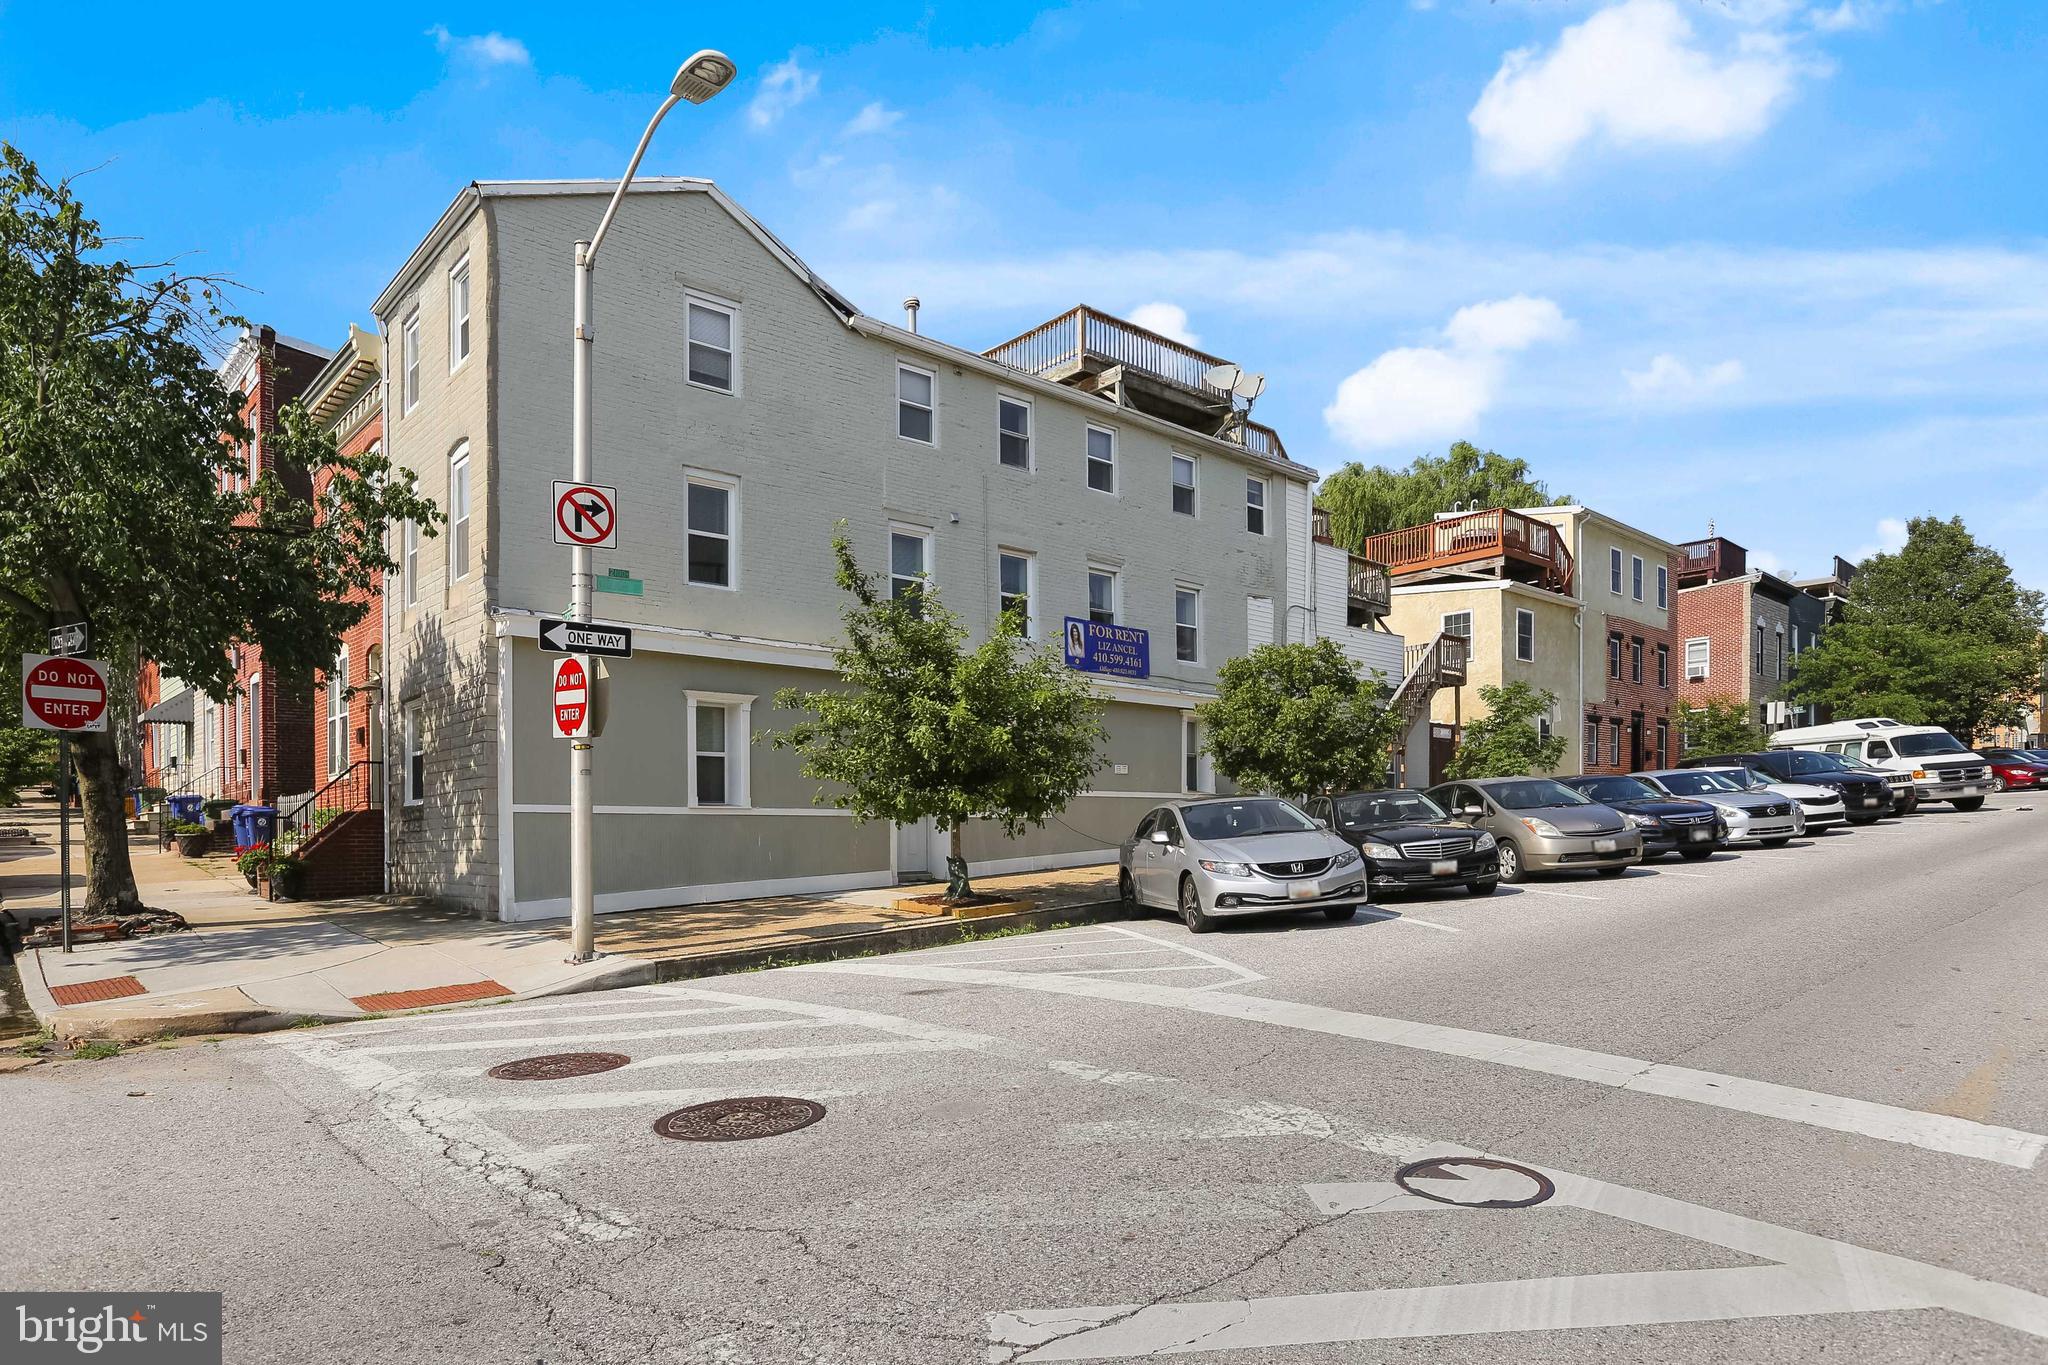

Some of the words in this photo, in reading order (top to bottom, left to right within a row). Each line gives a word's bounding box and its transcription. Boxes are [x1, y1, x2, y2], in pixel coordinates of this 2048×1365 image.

[567, 631, 593, 645] ONE
[597, 634, 622, 648] WAY
[1088, 624, 1113, 639] FOR
[1115, 628, 1145, 644] RENT
[1097, 641, 1111, 651] LIZ
[1092, 652, 1142, 668] 410.599.4161
[38, 670, 59, 682] DO
[67, 672, 96, 686] NOT
[558, 674, 567, 687] DO
[569, 672, 583, 686] NOT
[44, 702, 90, 716] ENTER
[559, 708, 580, 721] ENTER
